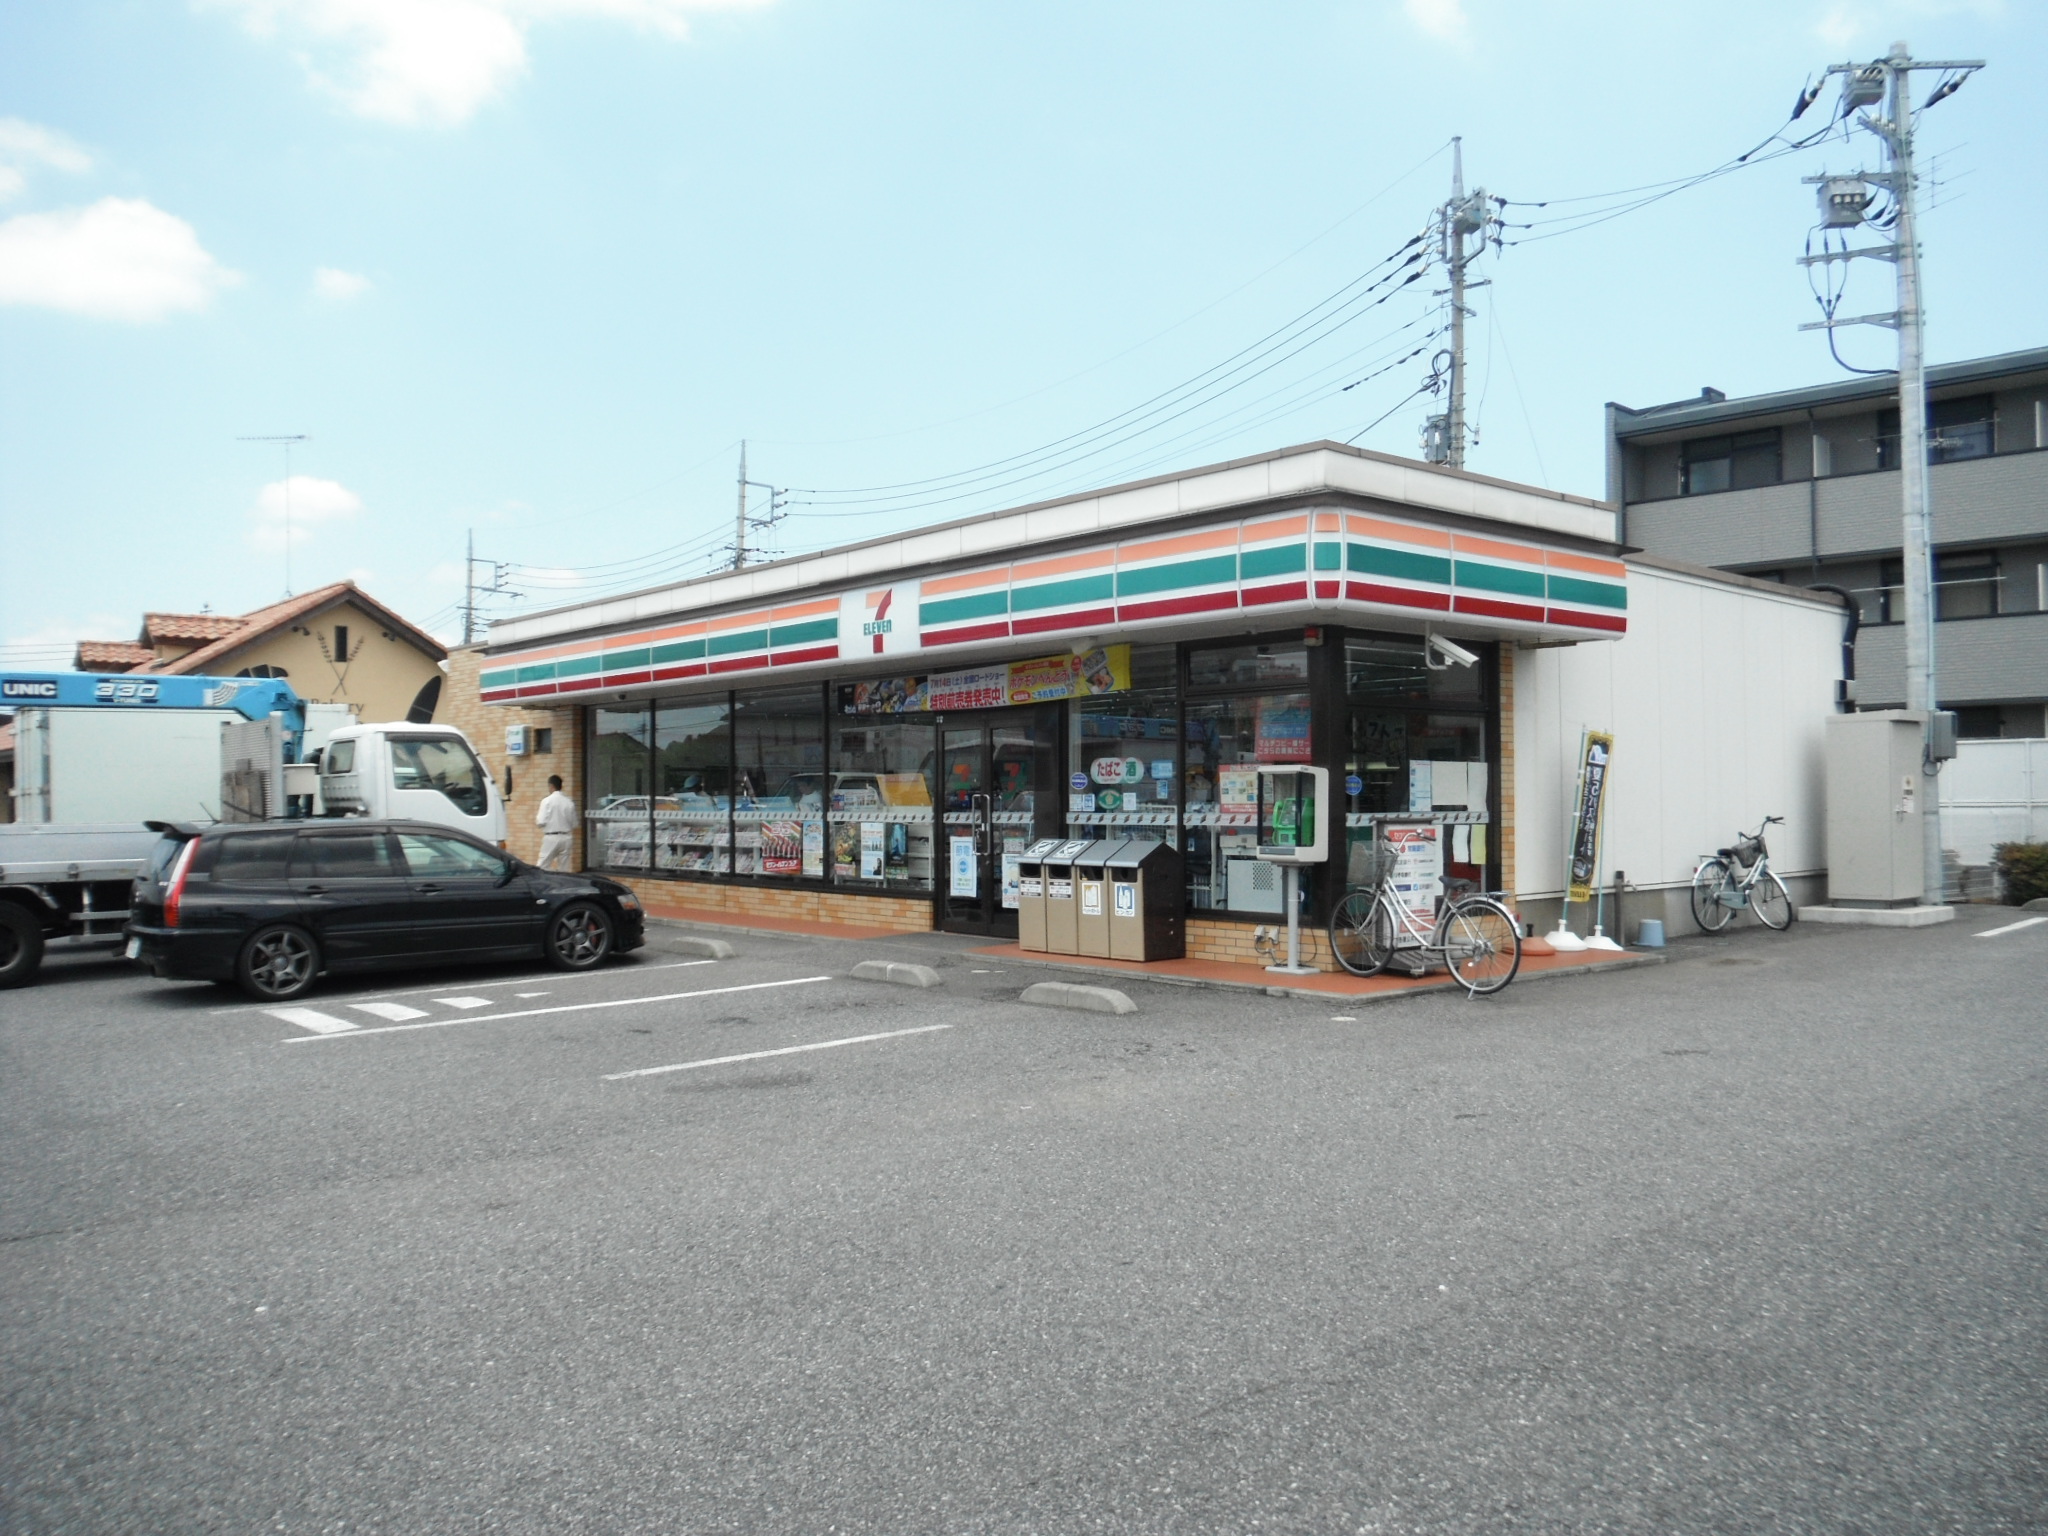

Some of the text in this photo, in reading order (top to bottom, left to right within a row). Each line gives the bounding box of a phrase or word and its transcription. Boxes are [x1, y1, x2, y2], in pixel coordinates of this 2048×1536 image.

[865, 587, 893, 654] 7
[3, 683, 56, 696] UNIC
[94, 683, 159, 697] 330
[1096, 761, 1121, 777] たばこ
[1125, 761, 1137, 777] 酒
